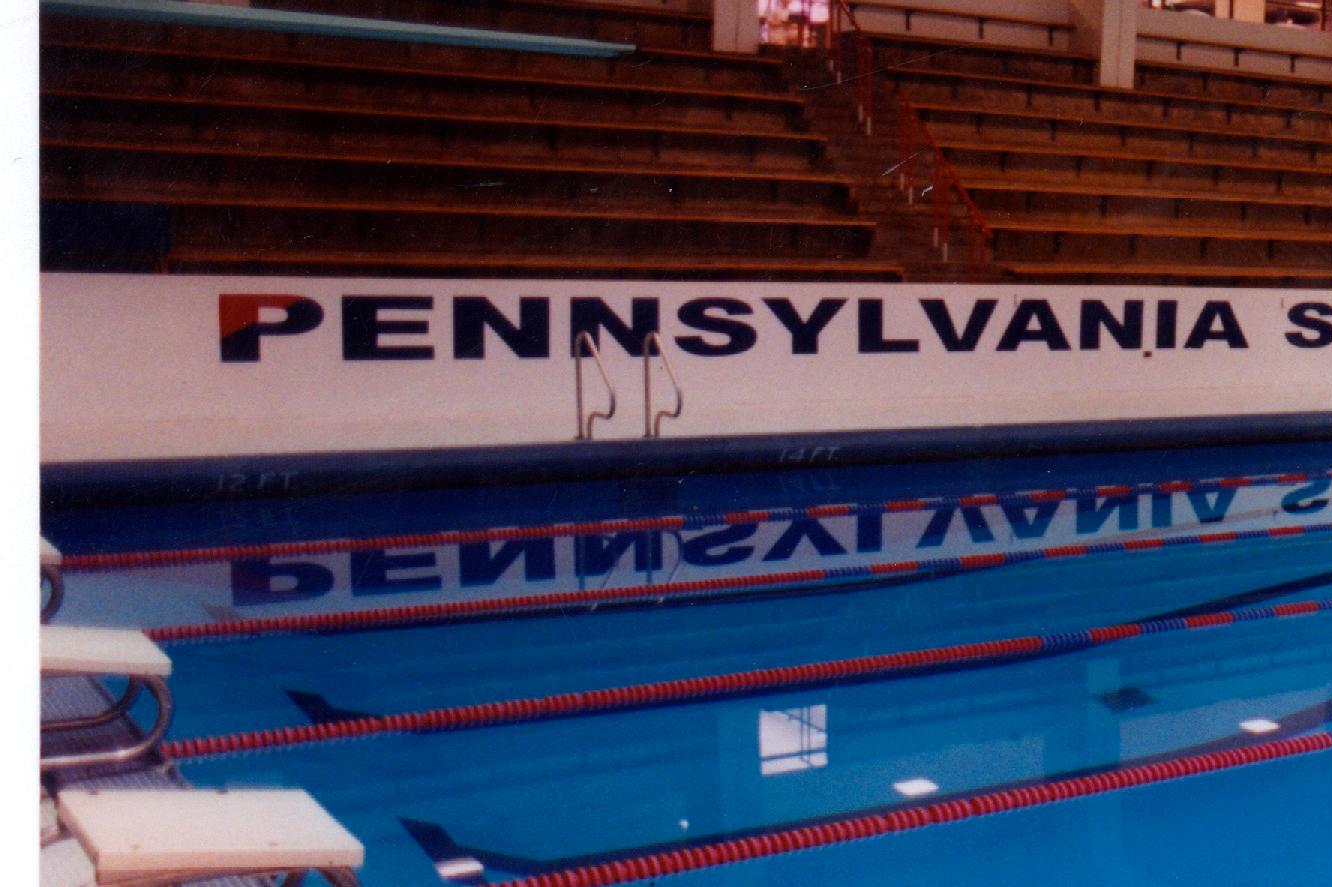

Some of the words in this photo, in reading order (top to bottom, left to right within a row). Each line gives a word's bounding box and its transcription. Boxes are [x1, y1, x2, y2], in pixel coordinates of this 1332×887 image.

[219, 294, 1248, 362] PENNSYLVANIA
[809, 446, 840, 462] FT
[257, 470, 298, 490] FT
